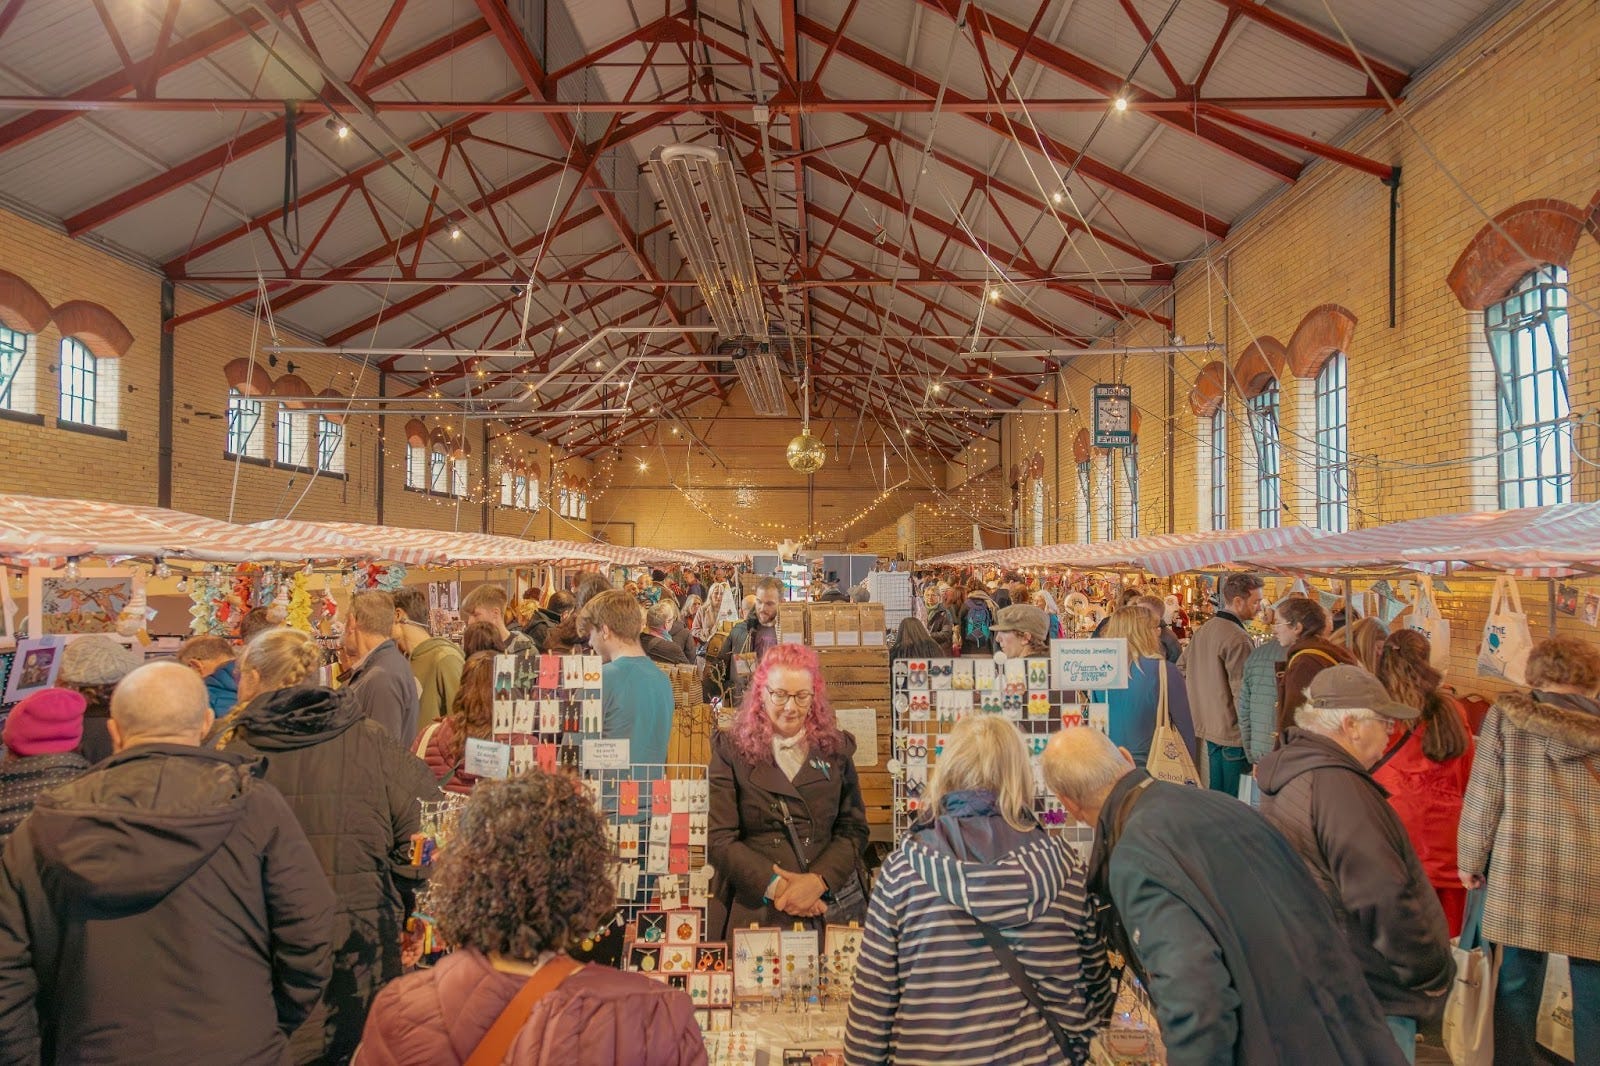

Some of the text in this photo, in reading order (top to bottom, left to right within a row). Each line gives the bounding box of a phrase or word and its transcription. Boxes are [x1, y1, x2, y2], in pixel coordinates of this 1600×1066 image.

[1060, 647, 1117, 656] Handmade Jewellery
[1070, 659, 1098, 675] Charm
[1158, 771, 1183, 782] School
